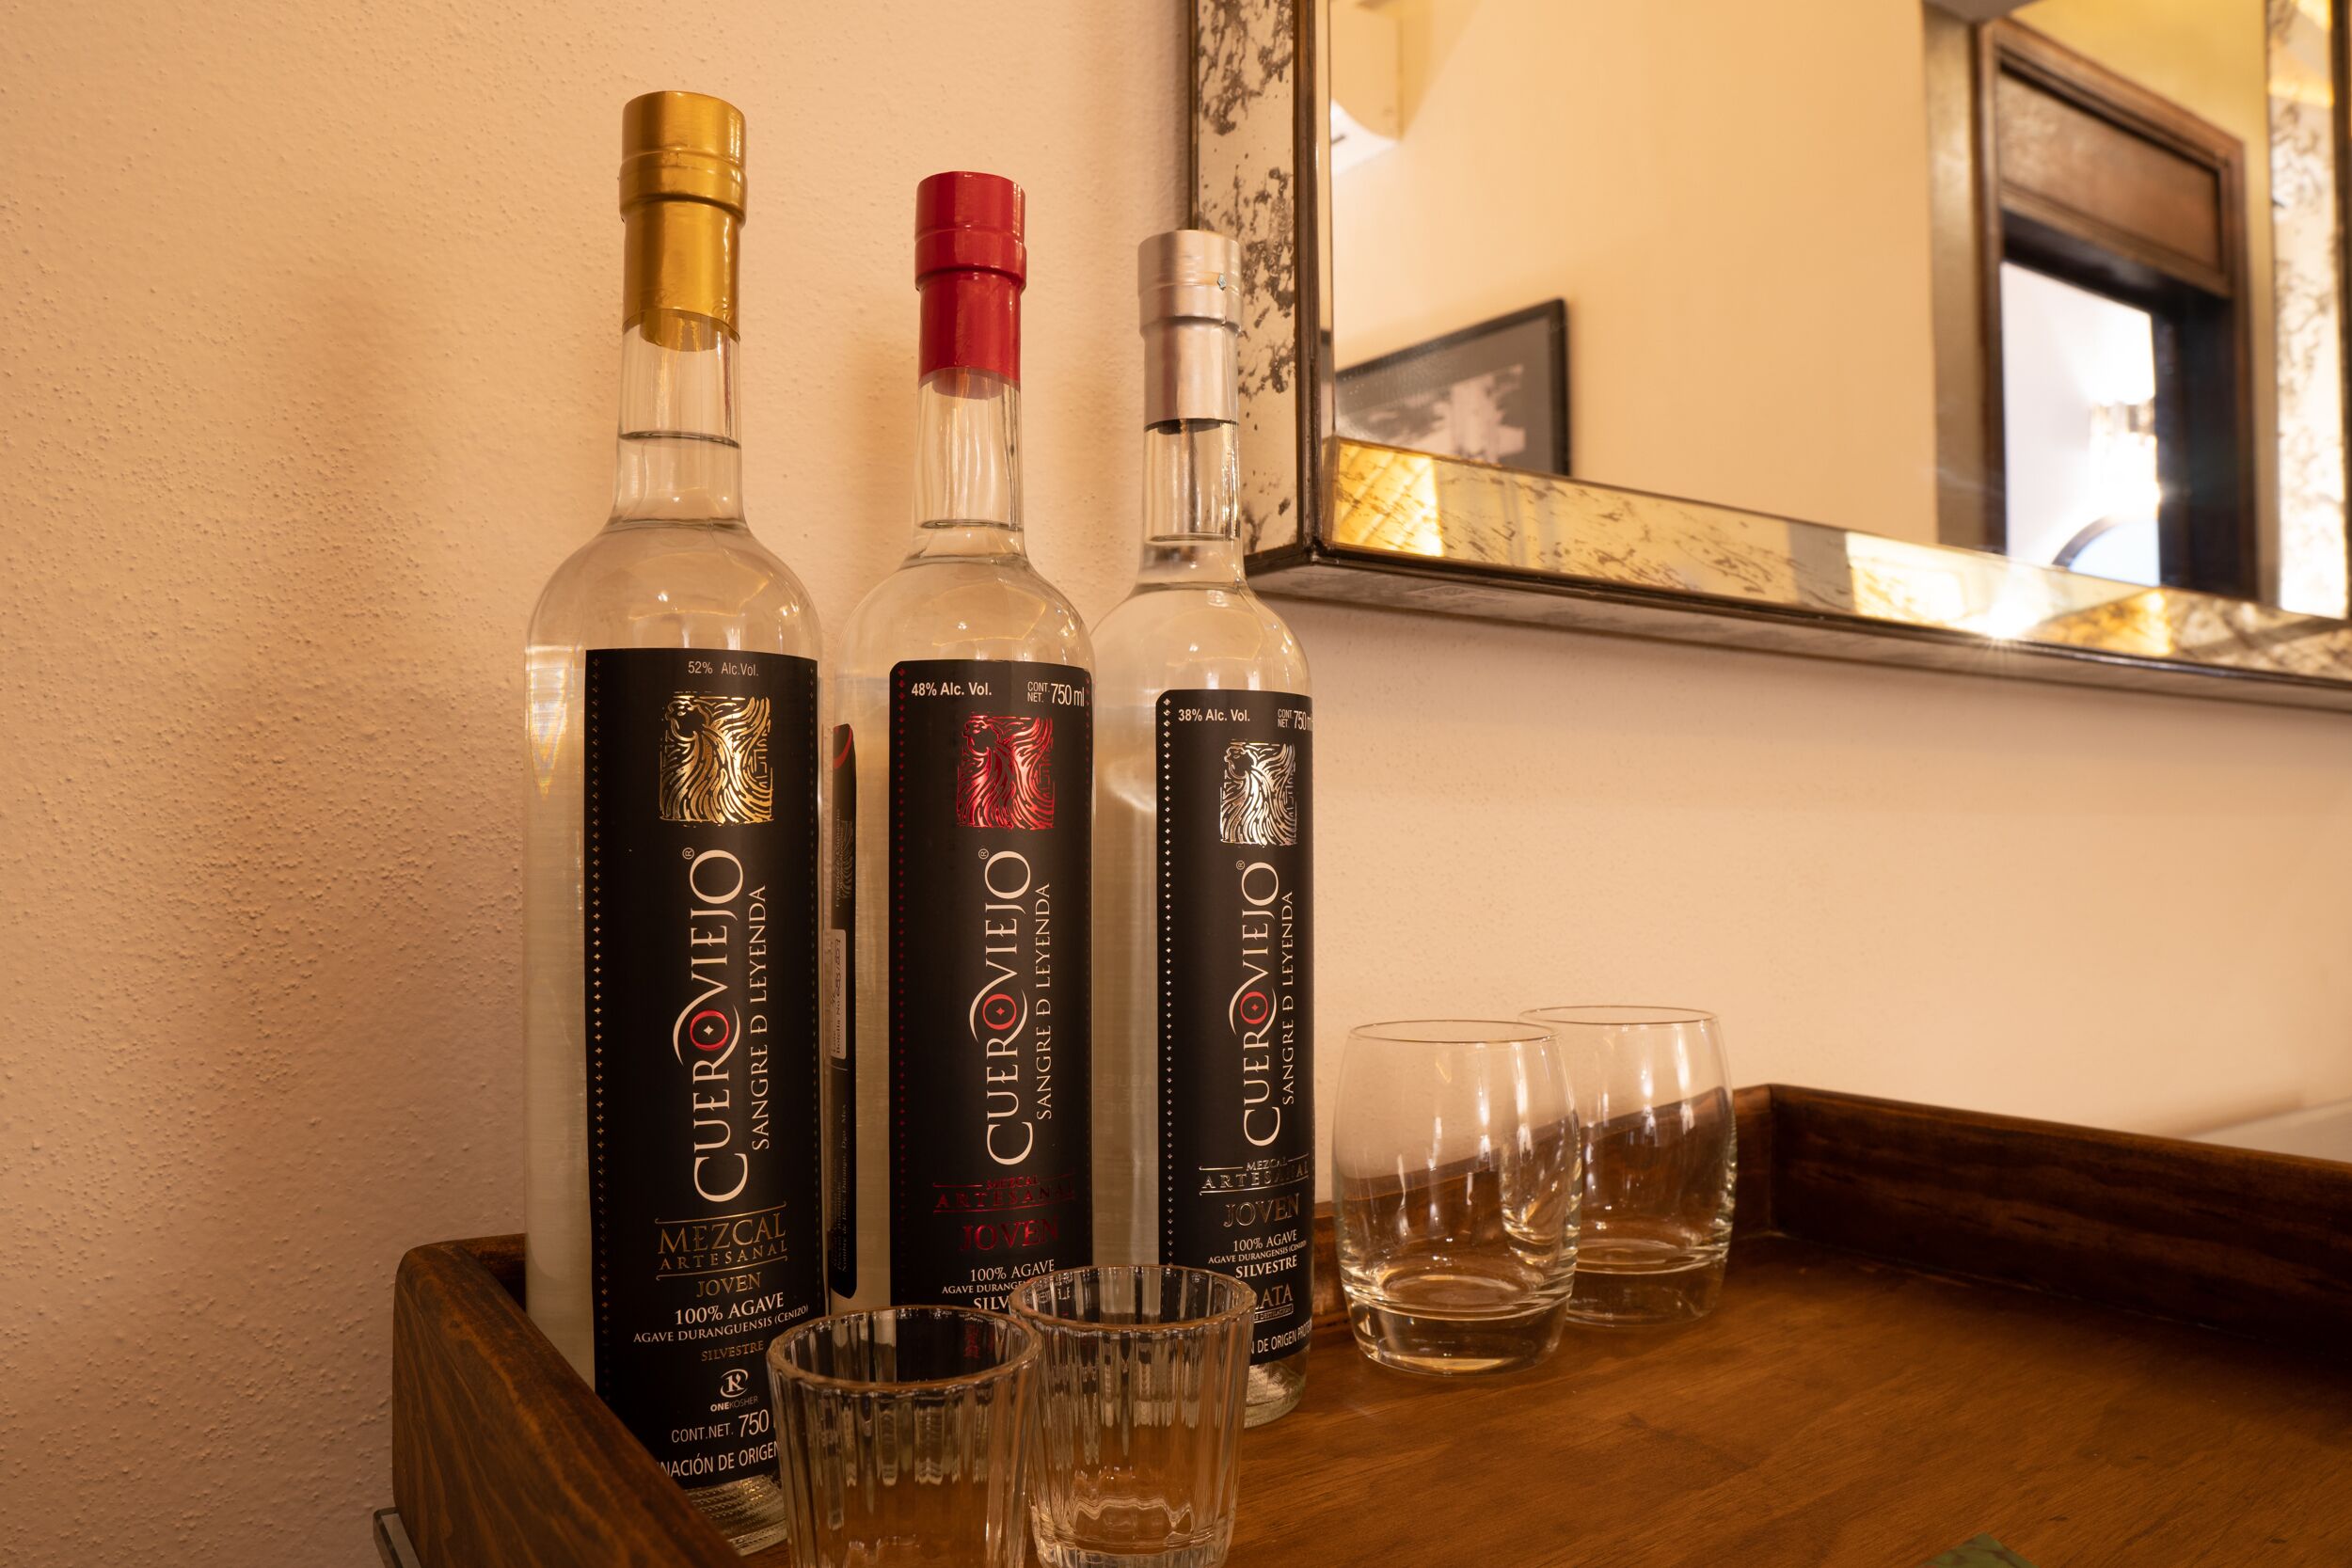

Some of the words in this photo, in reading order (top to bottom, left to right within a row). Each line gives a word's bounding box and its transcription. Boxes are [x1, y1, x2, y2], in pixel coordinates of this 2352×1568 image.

[688, 660, 713, 674] 52%
[911, 682, 937, 696] 48%
[940, 682, 964, 696] Alc.
[968, 682, 993, 696] Vol.
[1027, 681, 1051, 693] CONT.
[1051, 683, 1072, 705] 750
[1027, 691, 1044, 704] NET.
[1178, 708, 1203, 721] 38%
[1205, 708, 1228, 721] Alc.
[1231, 709, 1250, 722] Vol.
[1294, 710, 1307, 731] 750
[748, 885, 768, 1004] LEYENDA
[1035, 882, 1052, 989] LEYENDA
[1281, 892, 1295, 988] LEYENDA
[1035, 1025, 1052, 1120] SANGRE
[1282, 1019, 1295, 1105] SANGRE
[750, 1044, 770, 1150] SANGRE
[1247, 1156, 1287, 1171] MEZCAL
[986, 1175, 1039, 1190] MEZCAL
[1223, 1192, 1300, 1227] JOVEN
[657, 1212, 787, 1255] MEZCAL
[961, 1217, 1059, 1251] JOVEN
[1233, 1237, 1263, 1252] 100%
[1265, 1229, 1297, 1247] AGAVE
[659, 1240, 787, 1271] ARTESANAL
[1208, 1255, 1236, 1264] AGAVE
[1238, 1245, 1288, 1262] DURANGENSIS
[1235, 1255, 1297, 1279] SILVESTRE
[970, 1266, 1007, 1282] 100%
[1011, 1259, 1055, 1278] AGAVE
[695, 1272, 762, 1298] JOVEN
[942, 1285, 974, 1294] AGAVE
[675, 1305, 723, 1326] 100%
[727, 1291, 784, 1319] AGAVE
[973, 1295, 1009, 1310] SILV
[633, 1332, 674, 1344] AGAVE
[677, 1316, 772, 1341] DURANGUENSIS
[1257, 1338, 1269, 1354] DE
[1270, 1329, 1297, 1351] ORIGEN
[701, 1340, 765, 1362] SILVESTRE
[738, 1409, 770, 1438] 750
[658, 1453, 714, 1478] NACIÓN
[718, 1451, 735, 1472] DE
